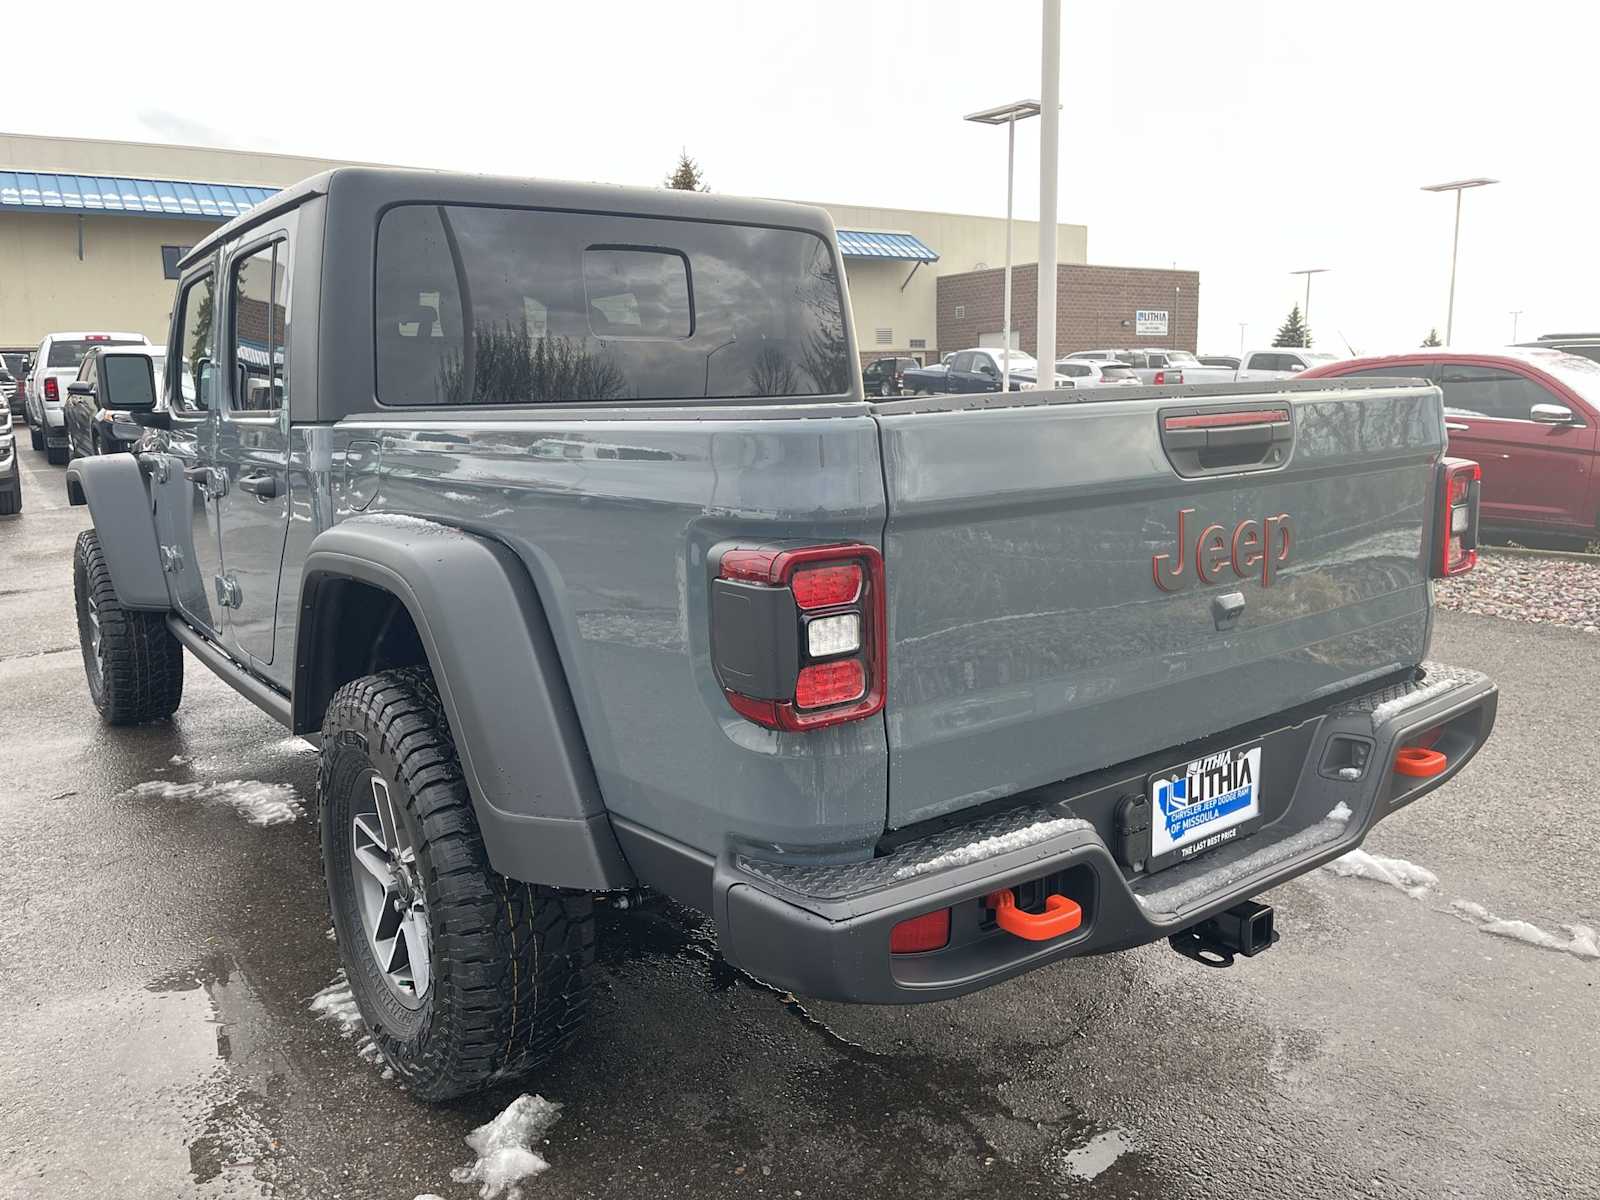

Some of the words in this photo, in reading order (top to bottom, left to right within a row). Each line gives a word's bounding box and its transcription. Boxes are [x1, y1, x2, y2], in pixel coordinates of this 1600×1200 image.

[1144, 312, 1166, 321] LITHIA
[1152, 508, 1295, 592] Jeep
[1197, 751, 1231, 772] LITHIA
[1187, 758, 1252, 806] LITHIA
[1171, 805, 1202, 822] CHRYSLER
[1202, 800, 1217, 811] JEEP
[1218, 793, 1237, 805] DODGE
[1171, 821, 1182, 833] OF
[1182, 809, 1219, 830] MISSOULA
[1182, 845, 1193, 856] THE
[1193, 840, 1207, 852] LAST
[1207, 834, 1221, 846] BEST
[1221, 828, 1237, 840] PRICE
